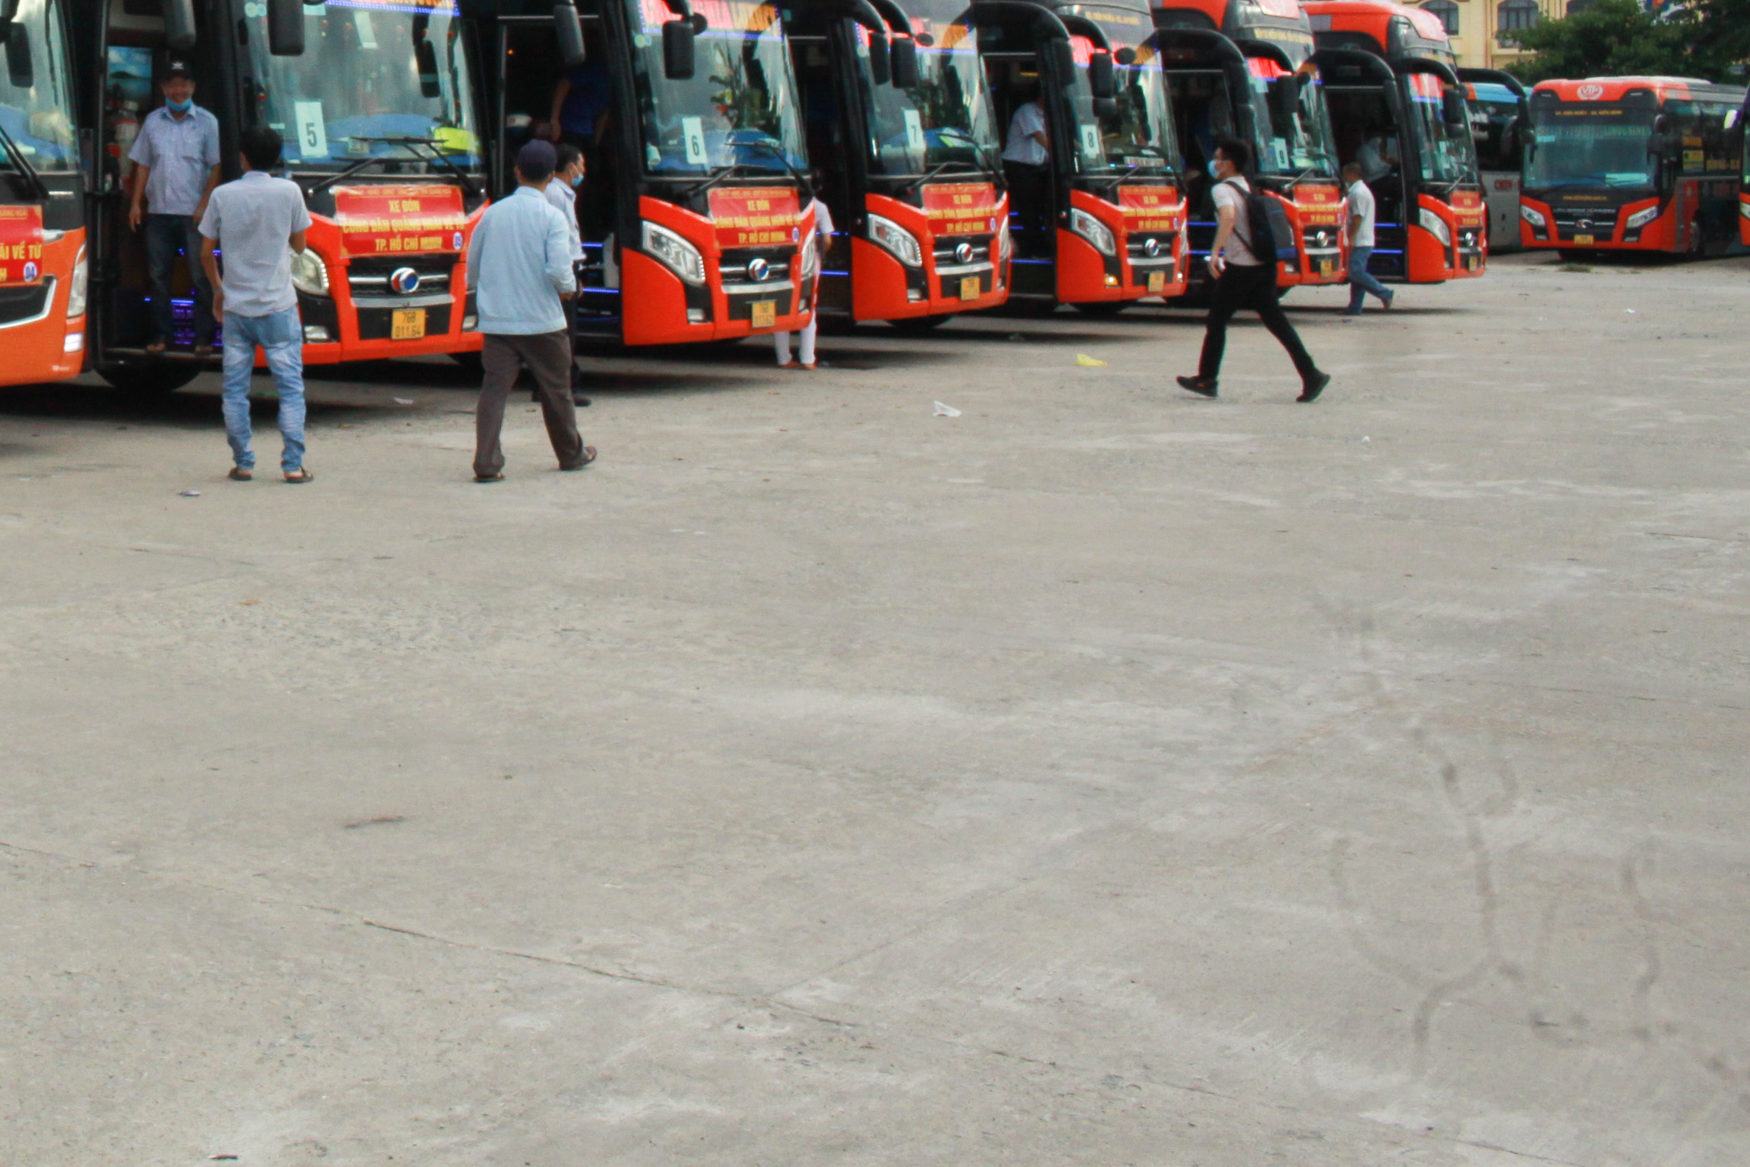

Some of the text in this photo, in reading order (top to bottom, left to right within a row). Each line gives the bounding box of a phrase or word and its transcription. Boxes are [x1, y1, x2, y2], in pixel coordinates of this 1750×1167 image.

[306, 122, 317, 148] 5
[1087, 131, 1094, 148] 8
[691, 135, 700, 156] 6
[375, 238, 388, 251] TP.
